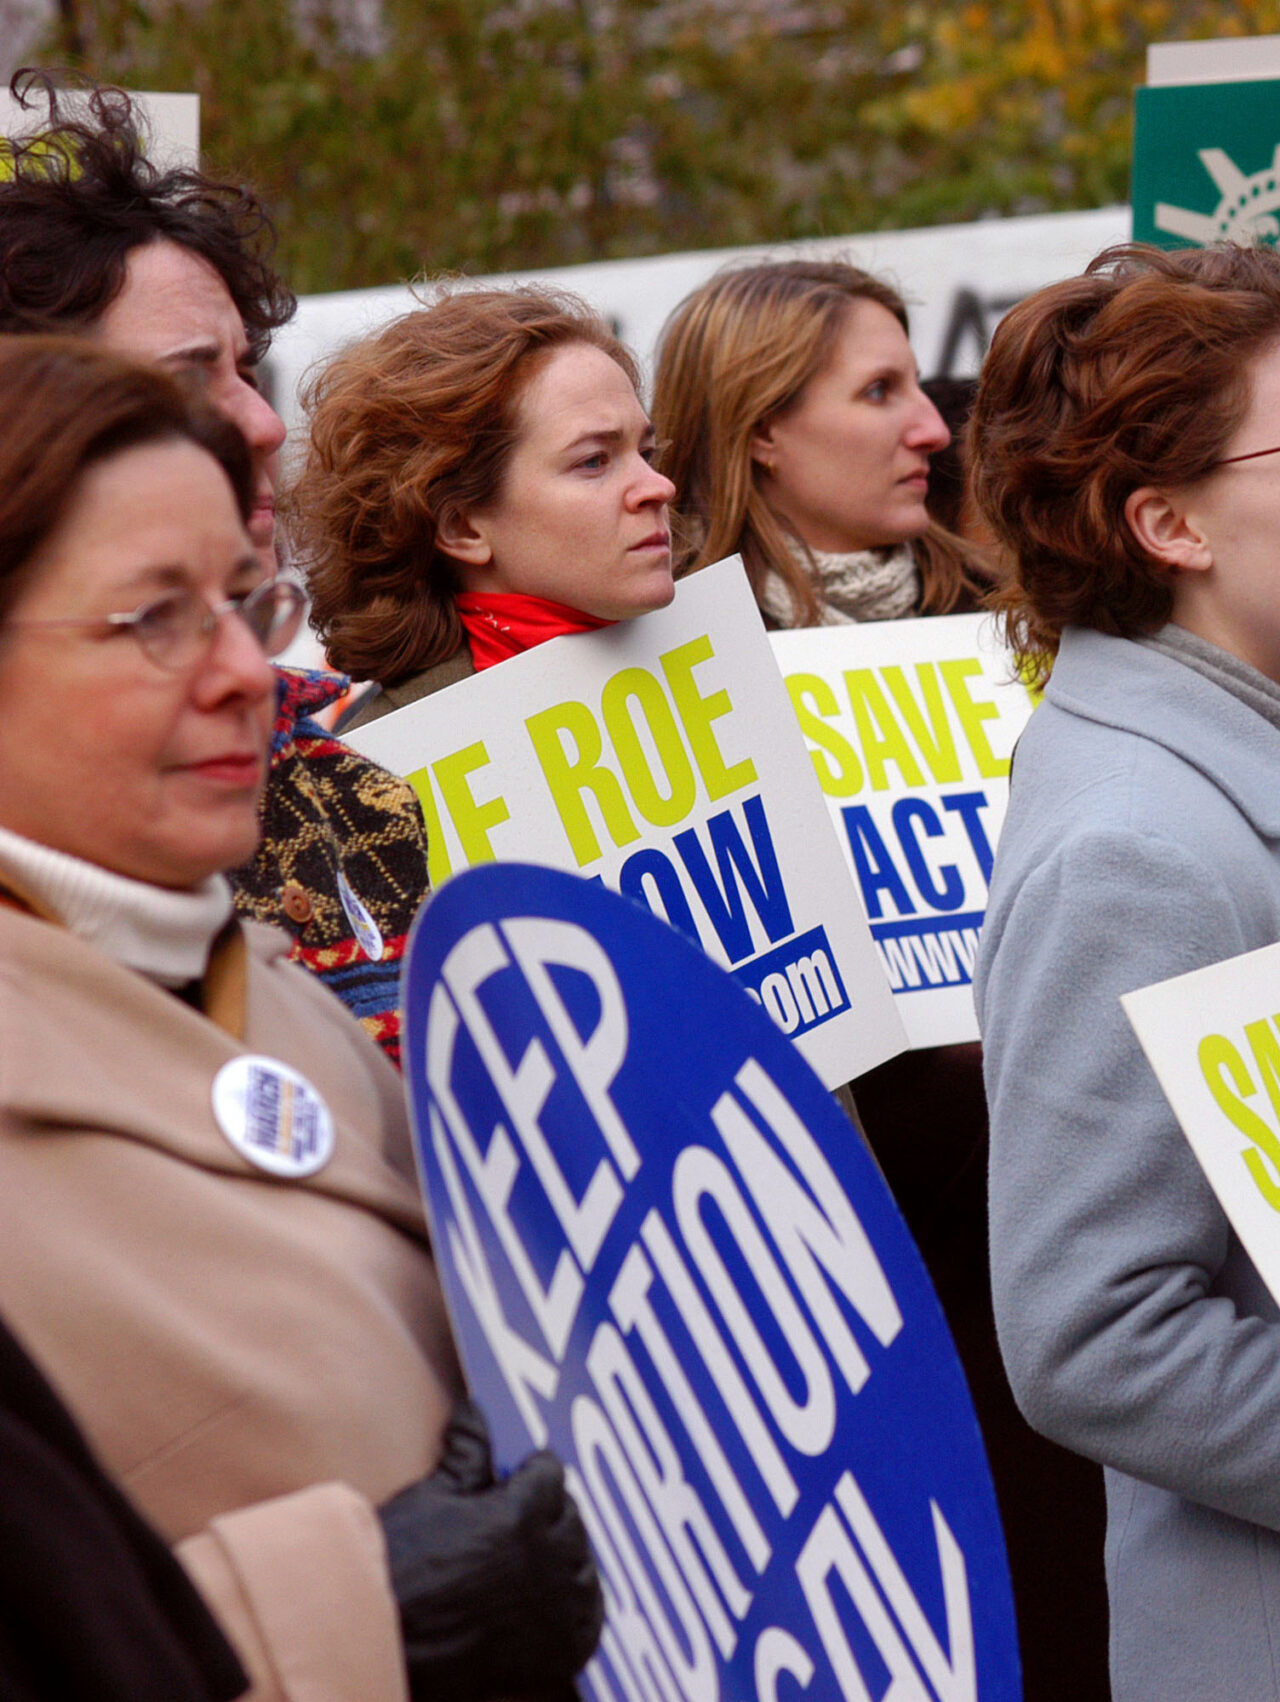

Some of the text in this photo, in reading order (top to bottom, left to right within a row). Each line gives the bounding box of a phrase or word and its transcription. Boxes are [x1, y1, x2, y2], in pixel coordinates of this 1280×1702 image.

[524, 634, 759, 868] ROE
[783, 657, 1012, 798] SAVE
[840, 790, 996, 919] ACT
[425, 916, 643, 1450] KEEP
